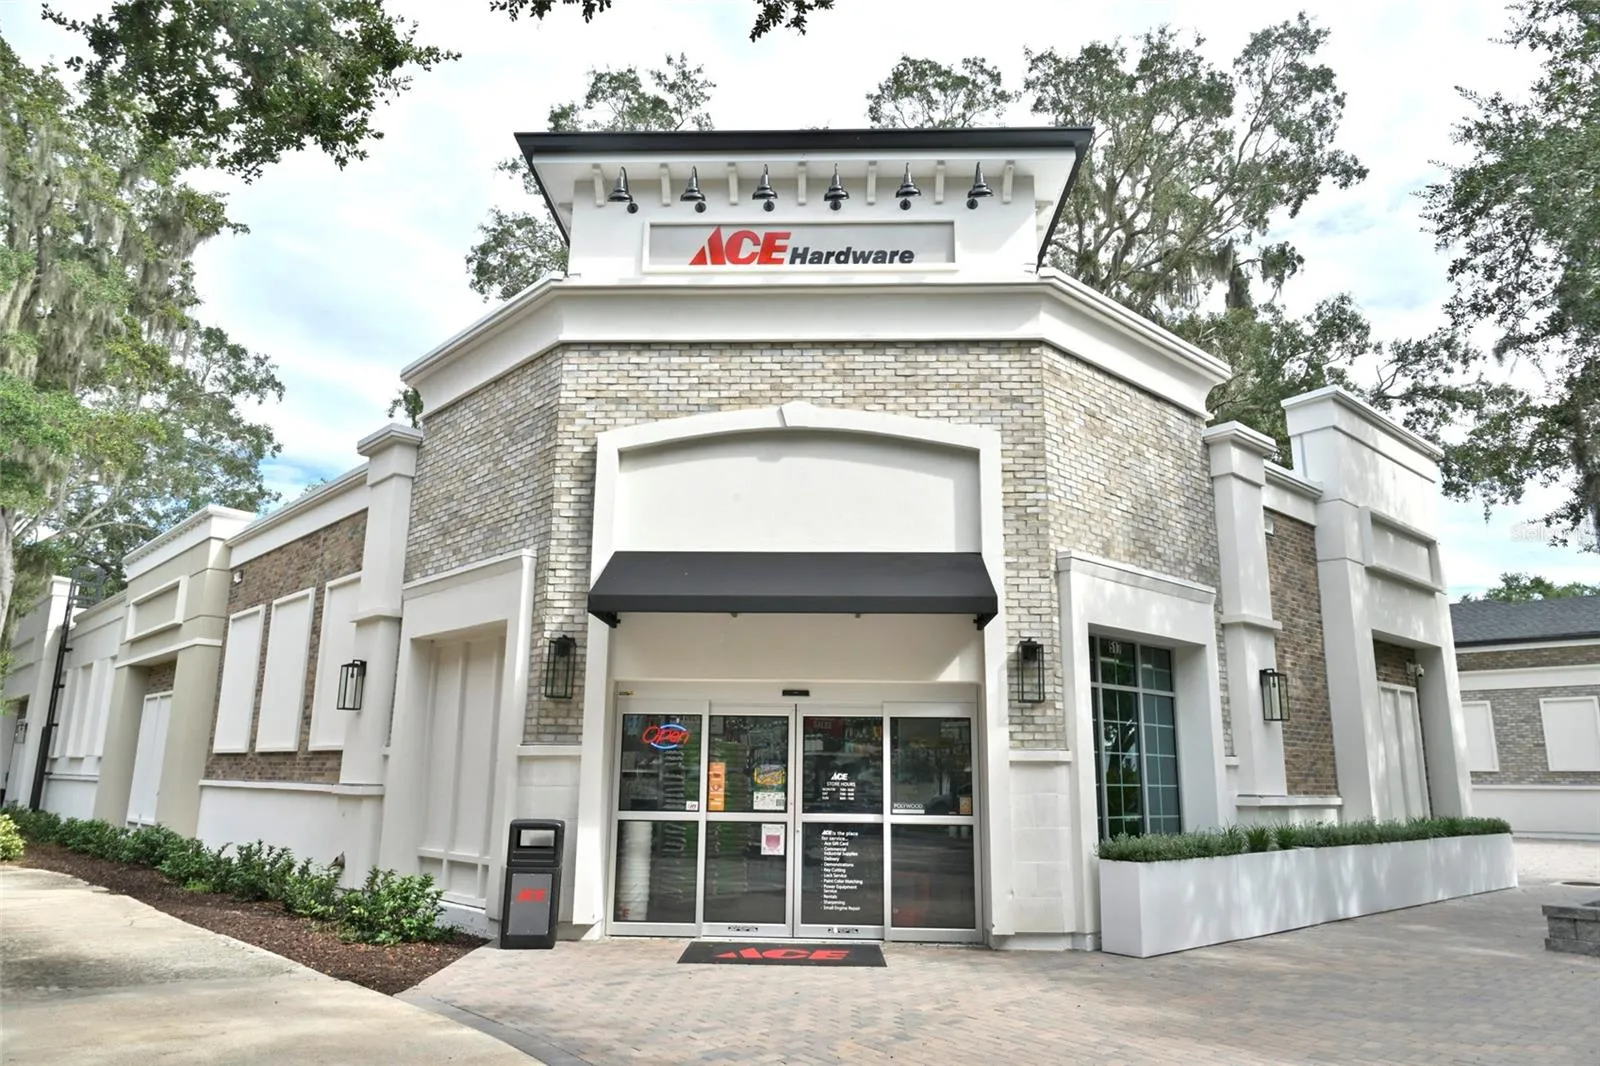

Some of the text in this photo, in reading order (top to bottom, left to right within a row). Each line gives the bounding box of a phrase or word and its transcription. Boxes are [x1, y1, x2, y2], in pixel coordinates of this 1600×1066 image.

[688, 225, 915, 266] ACE Hardware
[642, 725, 689, 745] Open
[831, 772, 848, 780] ACE
[715, 947, 850, 960] ACE
